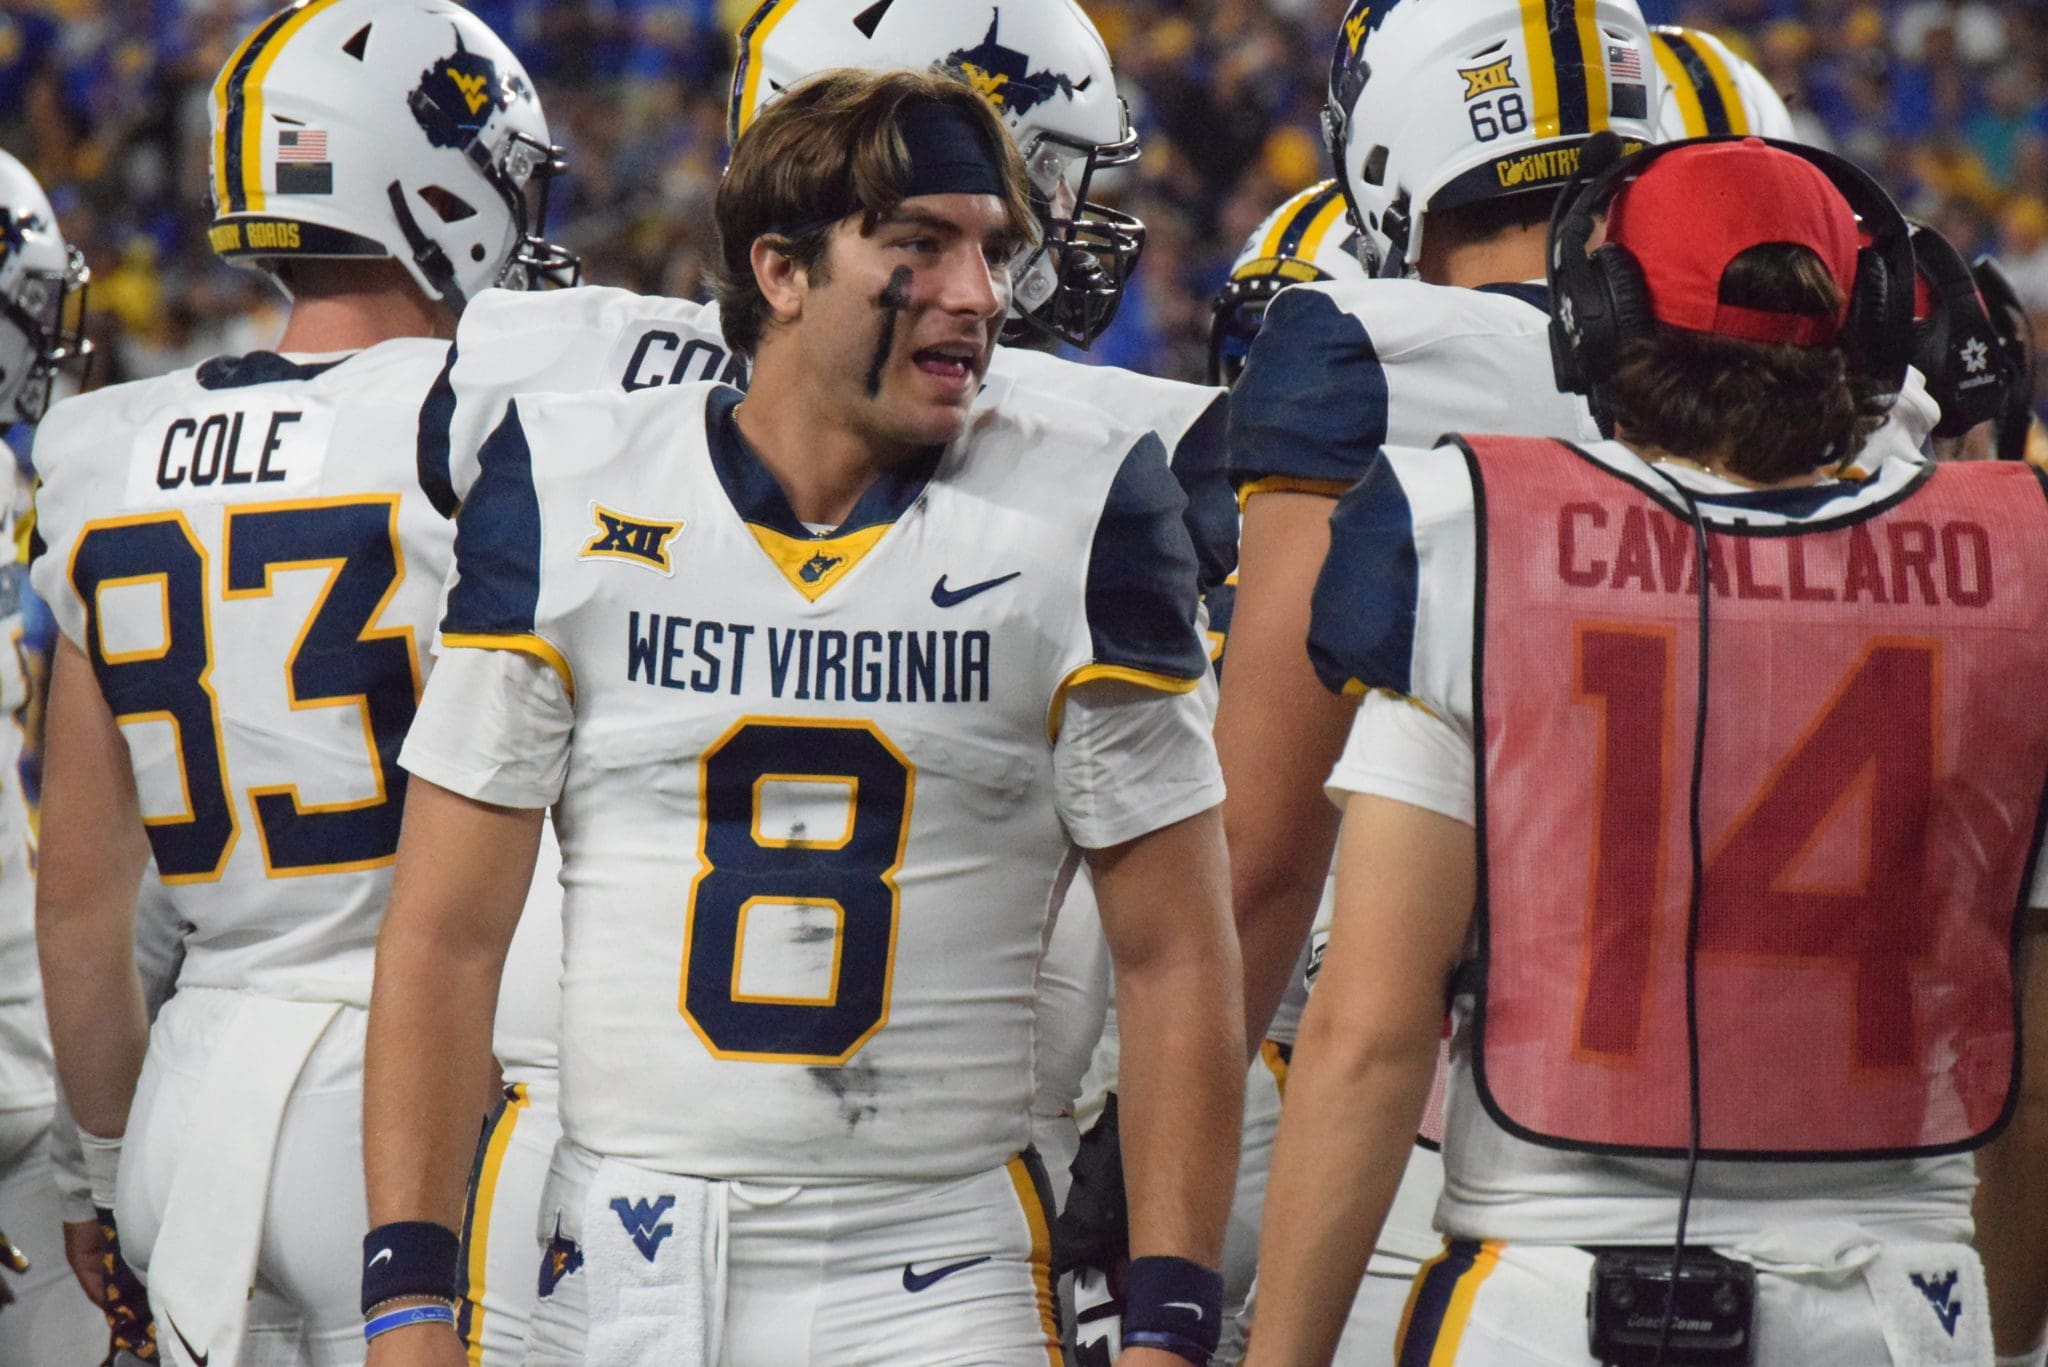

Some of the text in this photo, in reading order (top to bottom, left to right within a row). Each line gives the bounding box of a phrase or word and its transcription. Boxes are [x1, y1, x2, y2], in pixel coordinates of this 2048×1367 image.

[1469, 93, 1528, 142] 68
[157, 411, 303, 490] COLE
[1557, 502, 1994, 608] CAVALLARO
[67, 492, 423, 885] 83
[627, 611, 990, 703] WEST VIRGINIA
[679, 715, 916, 1065] 8
[1568, 620, 1950, 1080] 14
